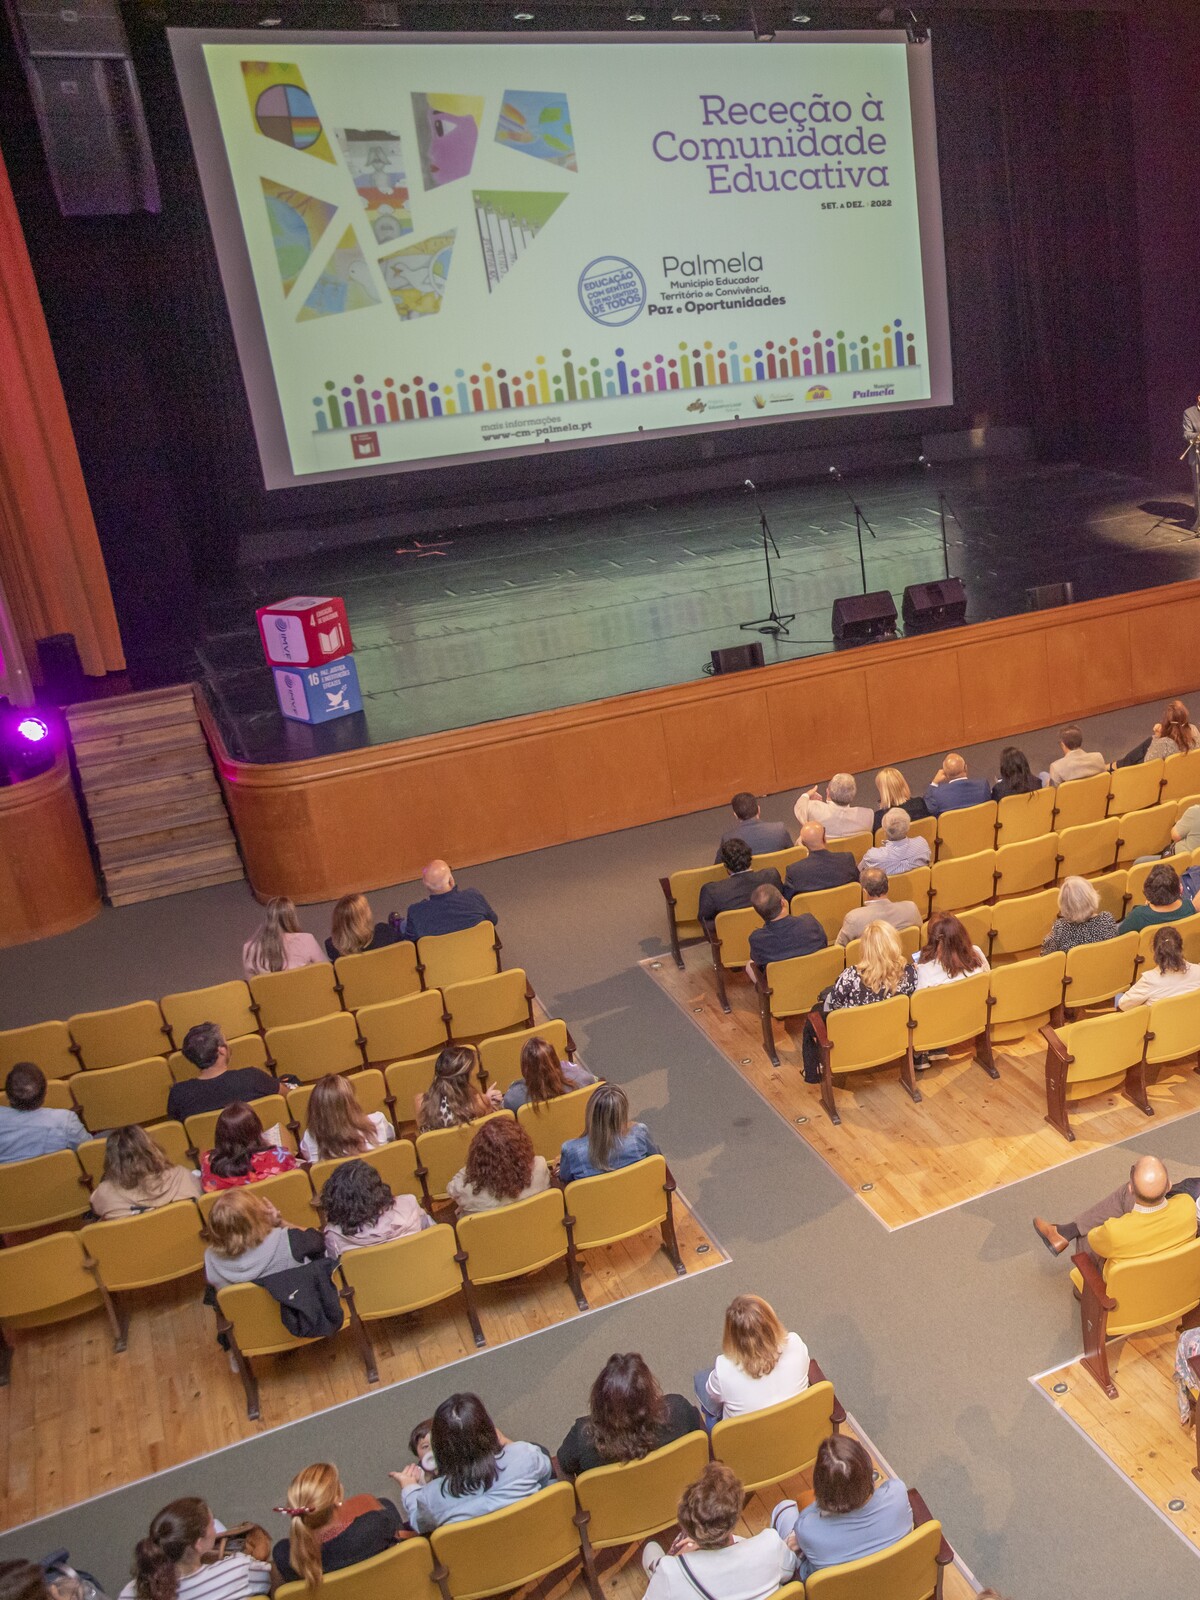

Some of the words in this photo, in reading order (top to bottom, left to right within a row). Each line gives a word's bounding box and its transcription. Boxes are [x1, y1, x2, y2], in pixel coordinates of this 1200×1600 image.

[699, 93, 852, 132] Receção
[861, 92, 885, 122] à
[652, 126, 887, 162] Comunidade
[706, 160, 890, 194] Educativa
[820, 202, 839, 210] SET.
[846, 200, 865, 209] DEZ.
[870, 199, 893, 208] 2022
[662, 251, 764, 278] Palmela
[584, 270, 633, 291] EDUCAÇÃO
[716, 275, 760, 287] Educador
[587, 290, 605, 300] COM
[591, 303, 606, 315] DE
[606, 293, 641, 310] TODOS
[648, 303, 674, 316] Paz
[684, 294, 787, 315] Oportunidades
[660, 290, 704, 301] Território
[852, 388, 895, 399] Palmela
[481, 423, 504, 432] mais
[505, 416, 562, 430] informações
[281, 633, 292, 660] IMVF
[308, 672, 320, 687] 16
